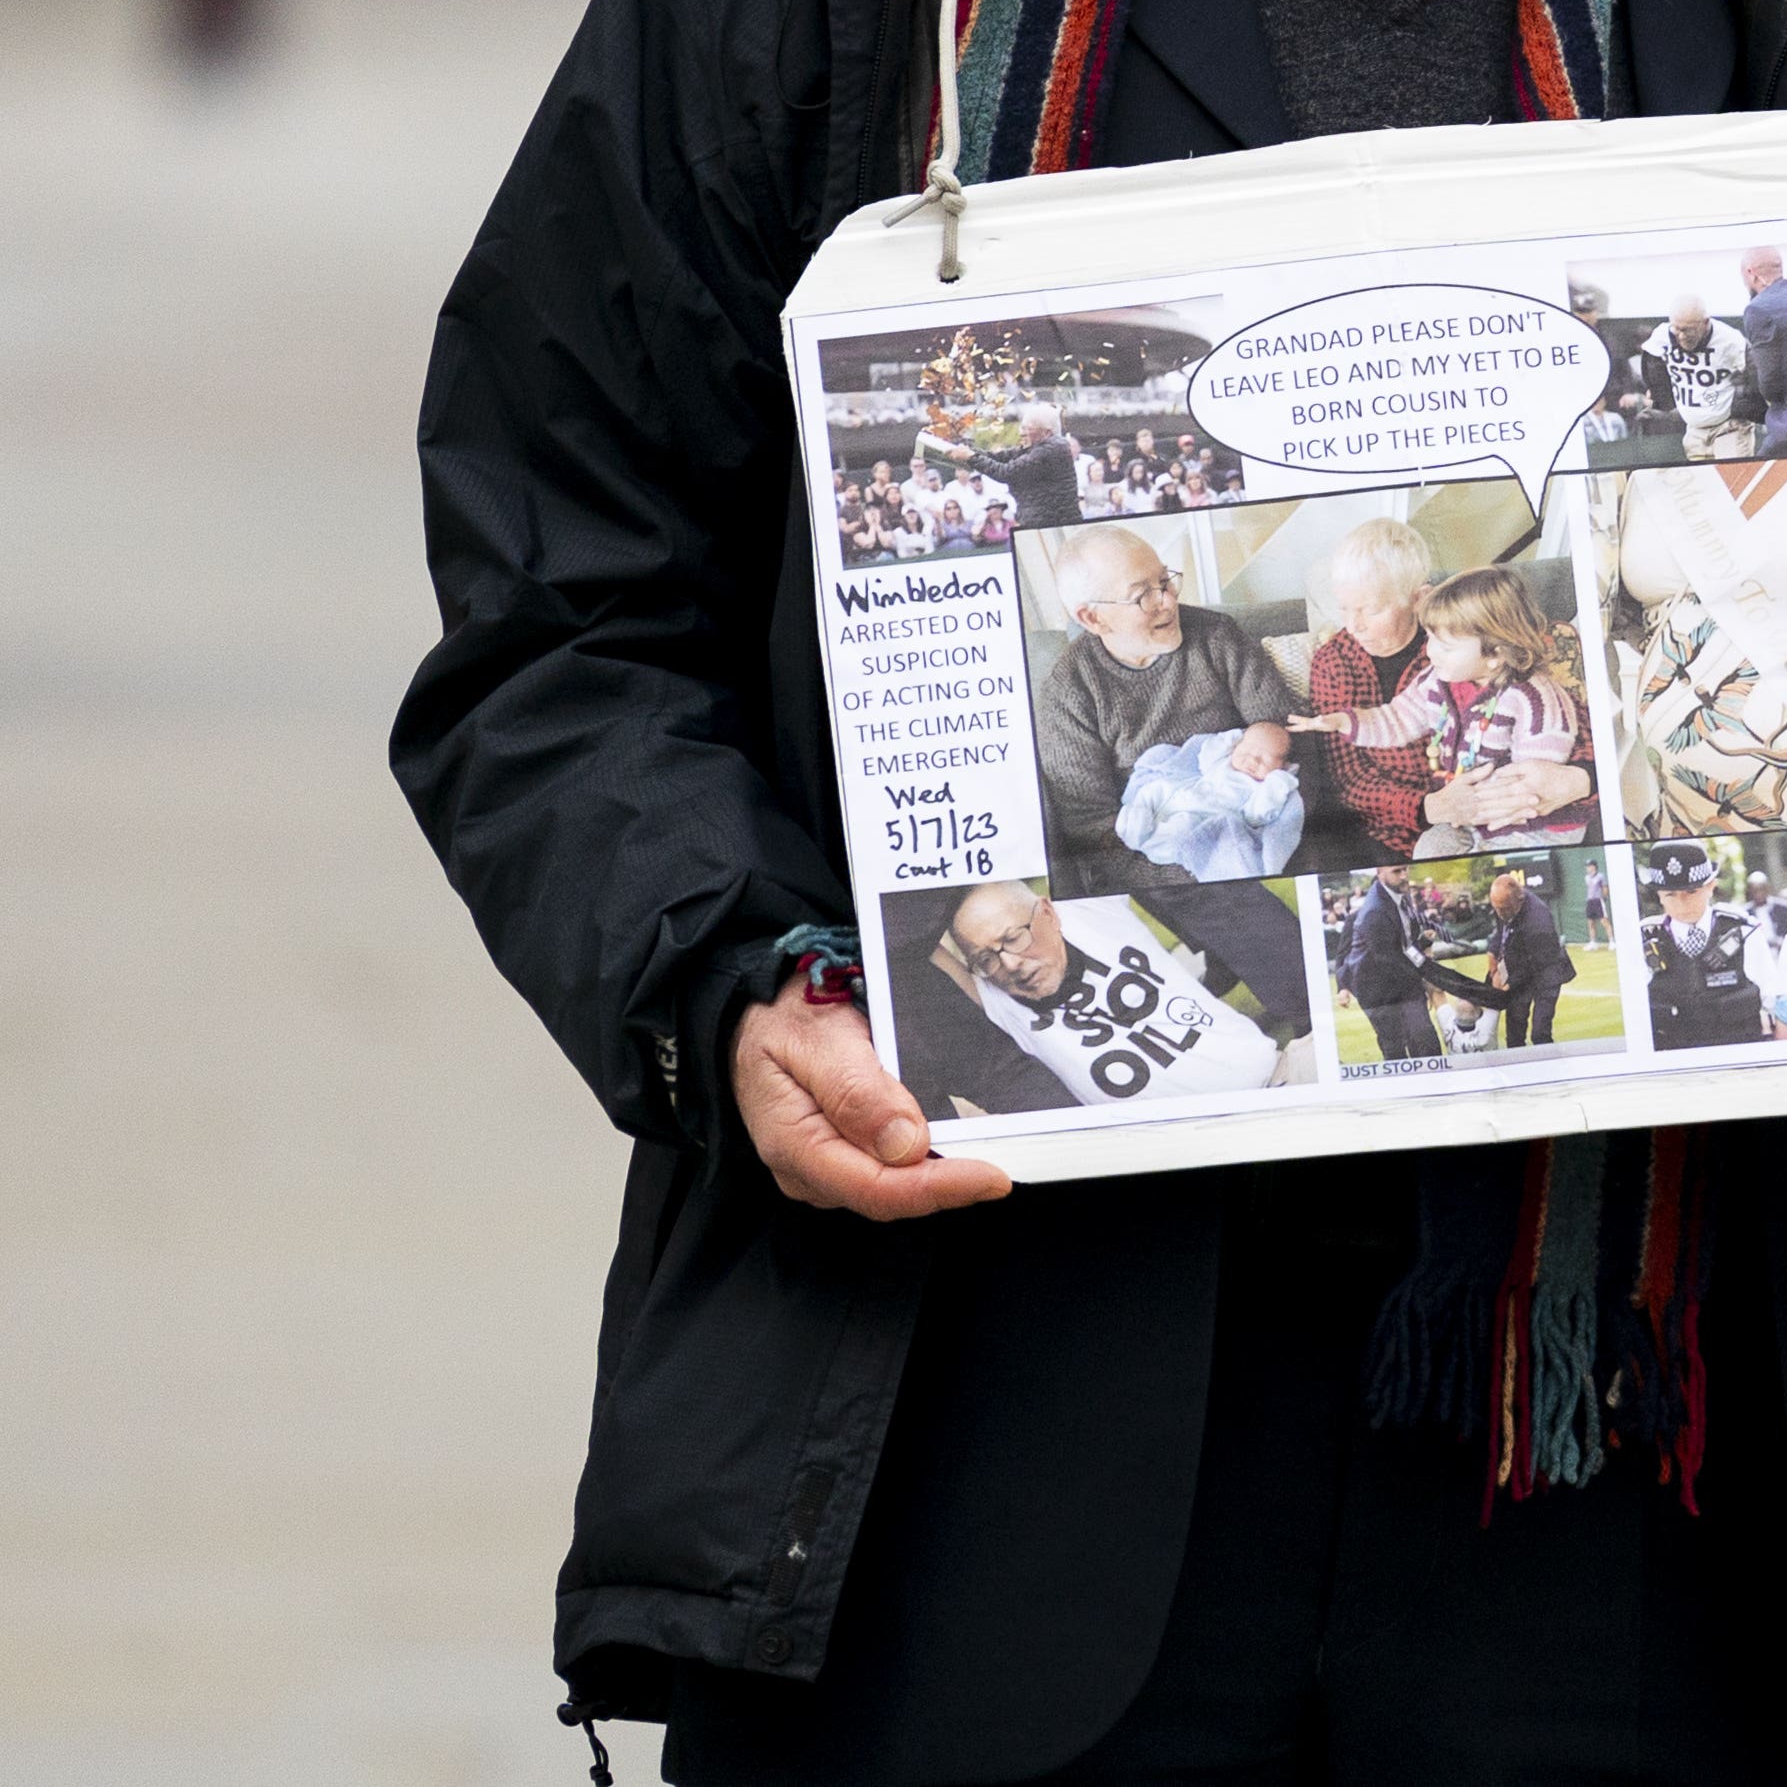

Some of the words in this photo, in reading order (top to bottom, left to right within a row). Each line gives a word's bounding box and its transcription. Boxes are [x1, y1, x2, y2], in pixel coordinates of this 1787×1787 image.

[1236, 326, 1363, 360] GRANDAD
[1373, 318, 1460, 344] PLEASE
[1469, 311, 1546, 336] DON'T
[1210, 372, 1285, 399] LEAVE
[1293, 365, 1339, 389] LEO
[1348, 358, 1401, 383] AND
[1412, 354, 1450, 377] MY
[1458, 351, 1501, 372] YET
[1509, 347, 1542, 368] TO
[1552, 344, 1581, 365] BE
[1670, 365, 1732, 387] STOP
[1292, 399, 1362, 425] BORN
[1372, 390, 1466, 414] COUSIN
[1475, 387, 1508, 406] TO
[1284, 438, 1337, 462] PICK
[1346, 433, 1379, 455] UP
[1387, 428, 1436, 450] THE
[1445, 421, 1526, 446] PIECES
[836, 571, 1003, 617] Wimbledon
[840, 615, 958, 645] ARRESTED
[967, 610, 1002, 630] ON
[862, 645, 987, 676] SUSPICION
[843, 692, 873, 711] OF
[882, 681, 970, 707] ACTING
[978, 676, 1013, 697] ON
[855, 722, 901, 743] THE
[908, 709, 1009, 738] CLIMATE
[863, 743, 1009, 776] EMERGENCY
[885, 782, 955, 809] Wed
[886, 809, 998, 853] 5/7/23
[966, 848, 993, 875] 18
[1062, 945, 1165, 1047] STOP
[1090, 1026, 1201, 1098] OIL
[1342, 1064, 1379, 1079] JUST
[1383, 1061, 1423, 1075] STOP
[1427, 1058, 1453, 1070] OIL
